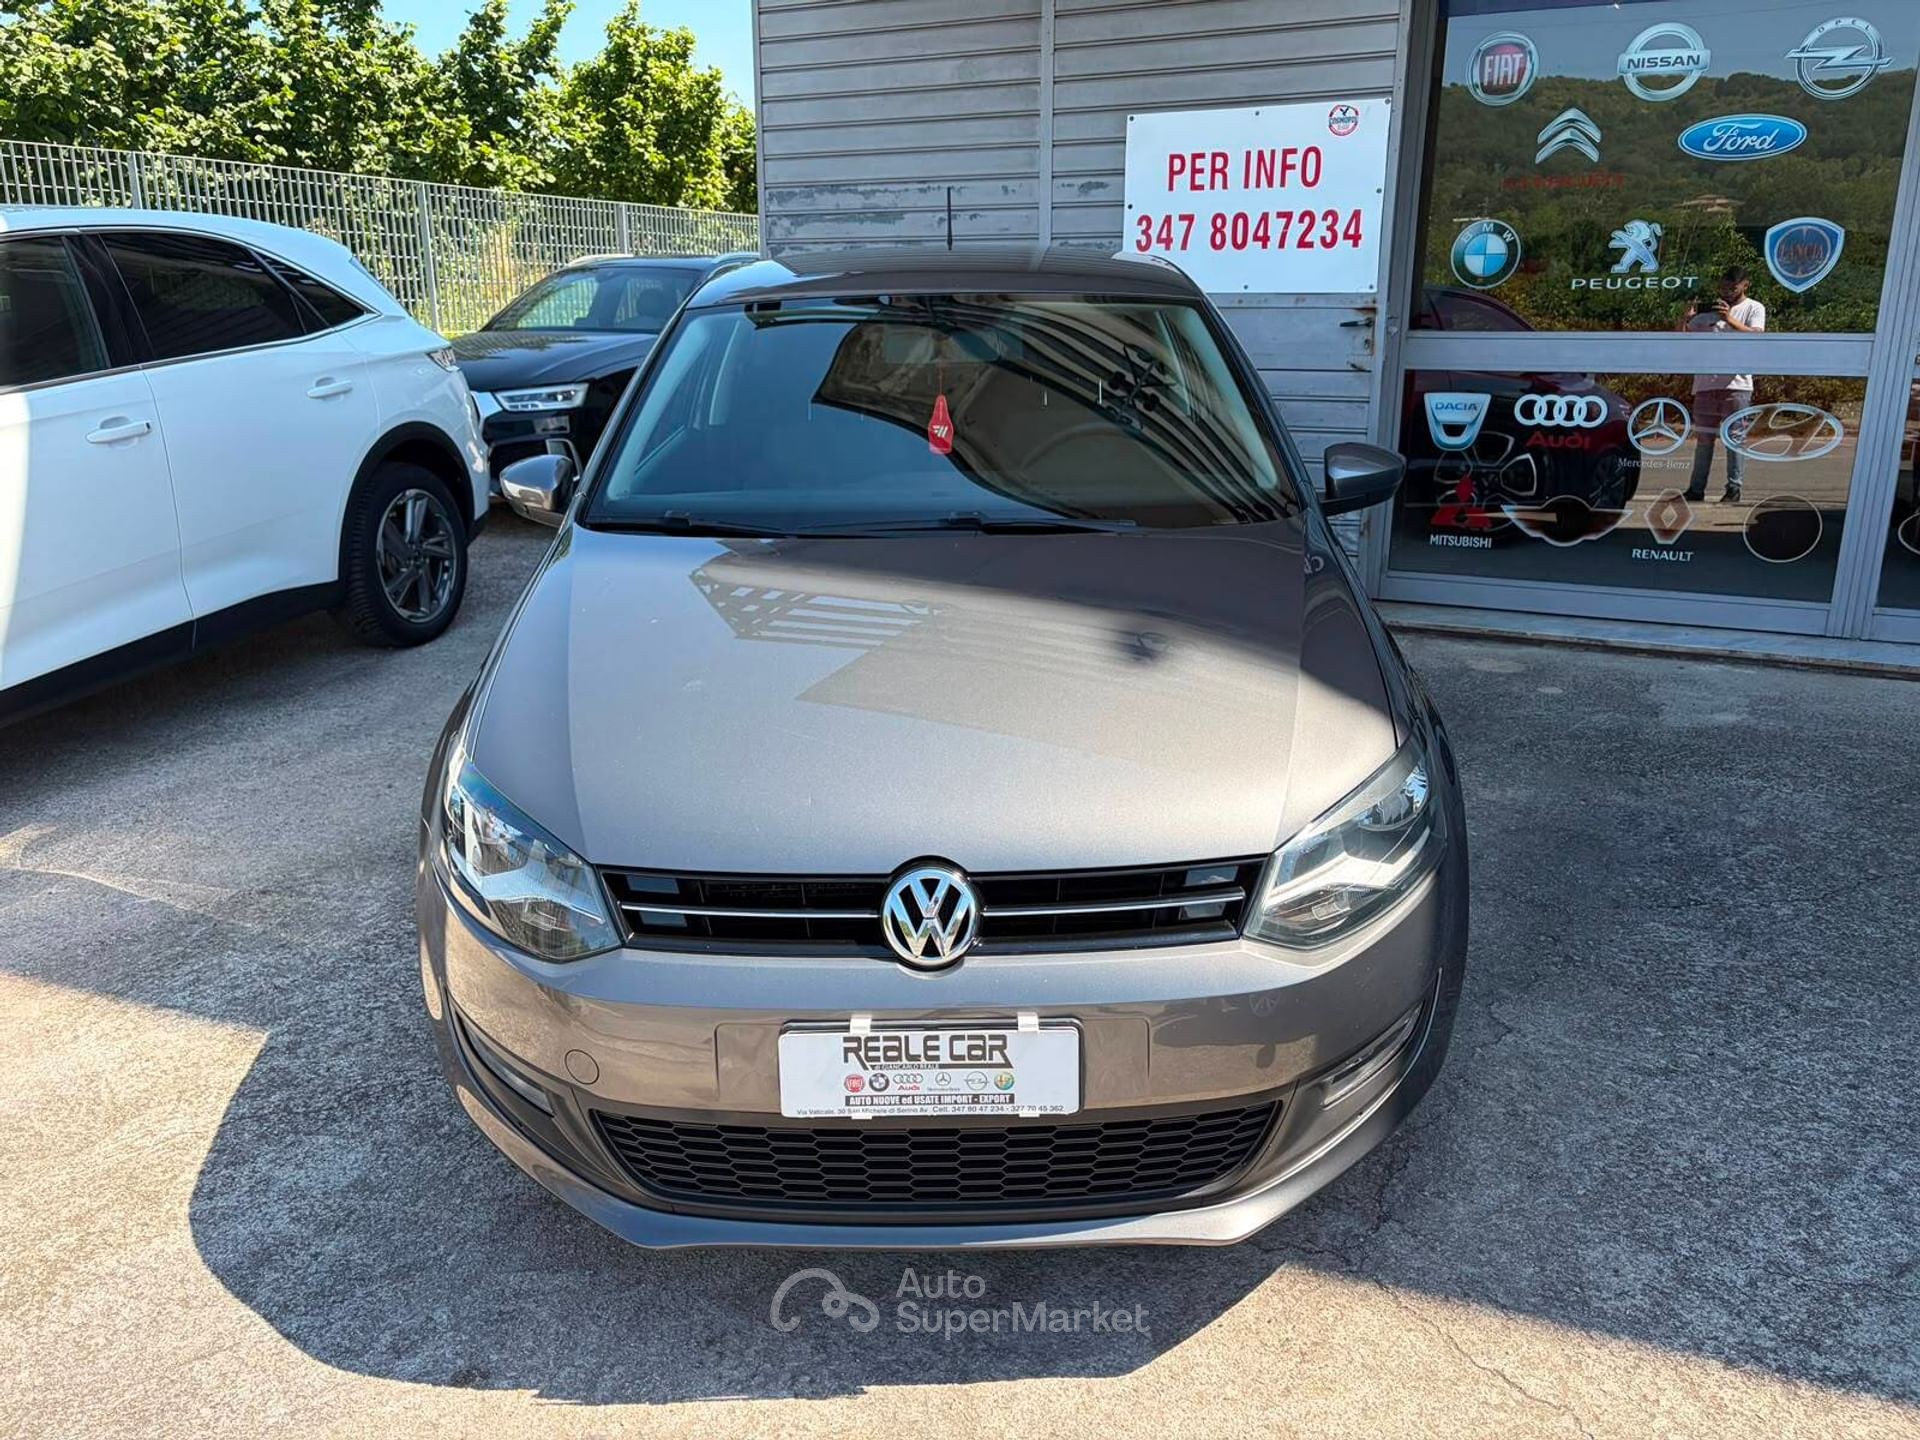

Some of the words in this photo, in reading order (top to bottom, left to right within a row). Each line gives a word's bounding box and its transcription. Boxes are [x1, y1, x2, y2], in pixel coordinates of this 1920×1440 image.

[1816, 19, 1871, 33] OPEL
[1627, 54, 1700, 69] NISSAN
[1484, 53, 1524, 86] FIAT
[1703, 121, 1779, 151] Ford
[1168, 152, 1230, 191] PER
[1243, 146, 1322, 189] INFO
[1135, 214, 1196, 252] 347
[1210, 209, 1362, 250] 8047234
[1461, 223, 1515, 244] BMW
[1571, 276, 1699, 290] PEUGEOT
[1435, 401, 1479, 412] DACIA
[1526, 431, 1591, 449] Audi
[1617, 457, 1691, 469] Mercedes-Benz
[1429, 534, 1493, 549] MITSUBISHI
[1631, 548, 1695, 562] RENAULT
[849, 1096, 872, 1105] AUTO
[873, 1095, 900, 1105] NUOVE
[902, 1096, 912, 1104] ed
[914, 1095, 939, 1104] USATE
[941, 1094, 973, 1104] IMPORT
[980, 1094, 1010, 1103] EXPORT
